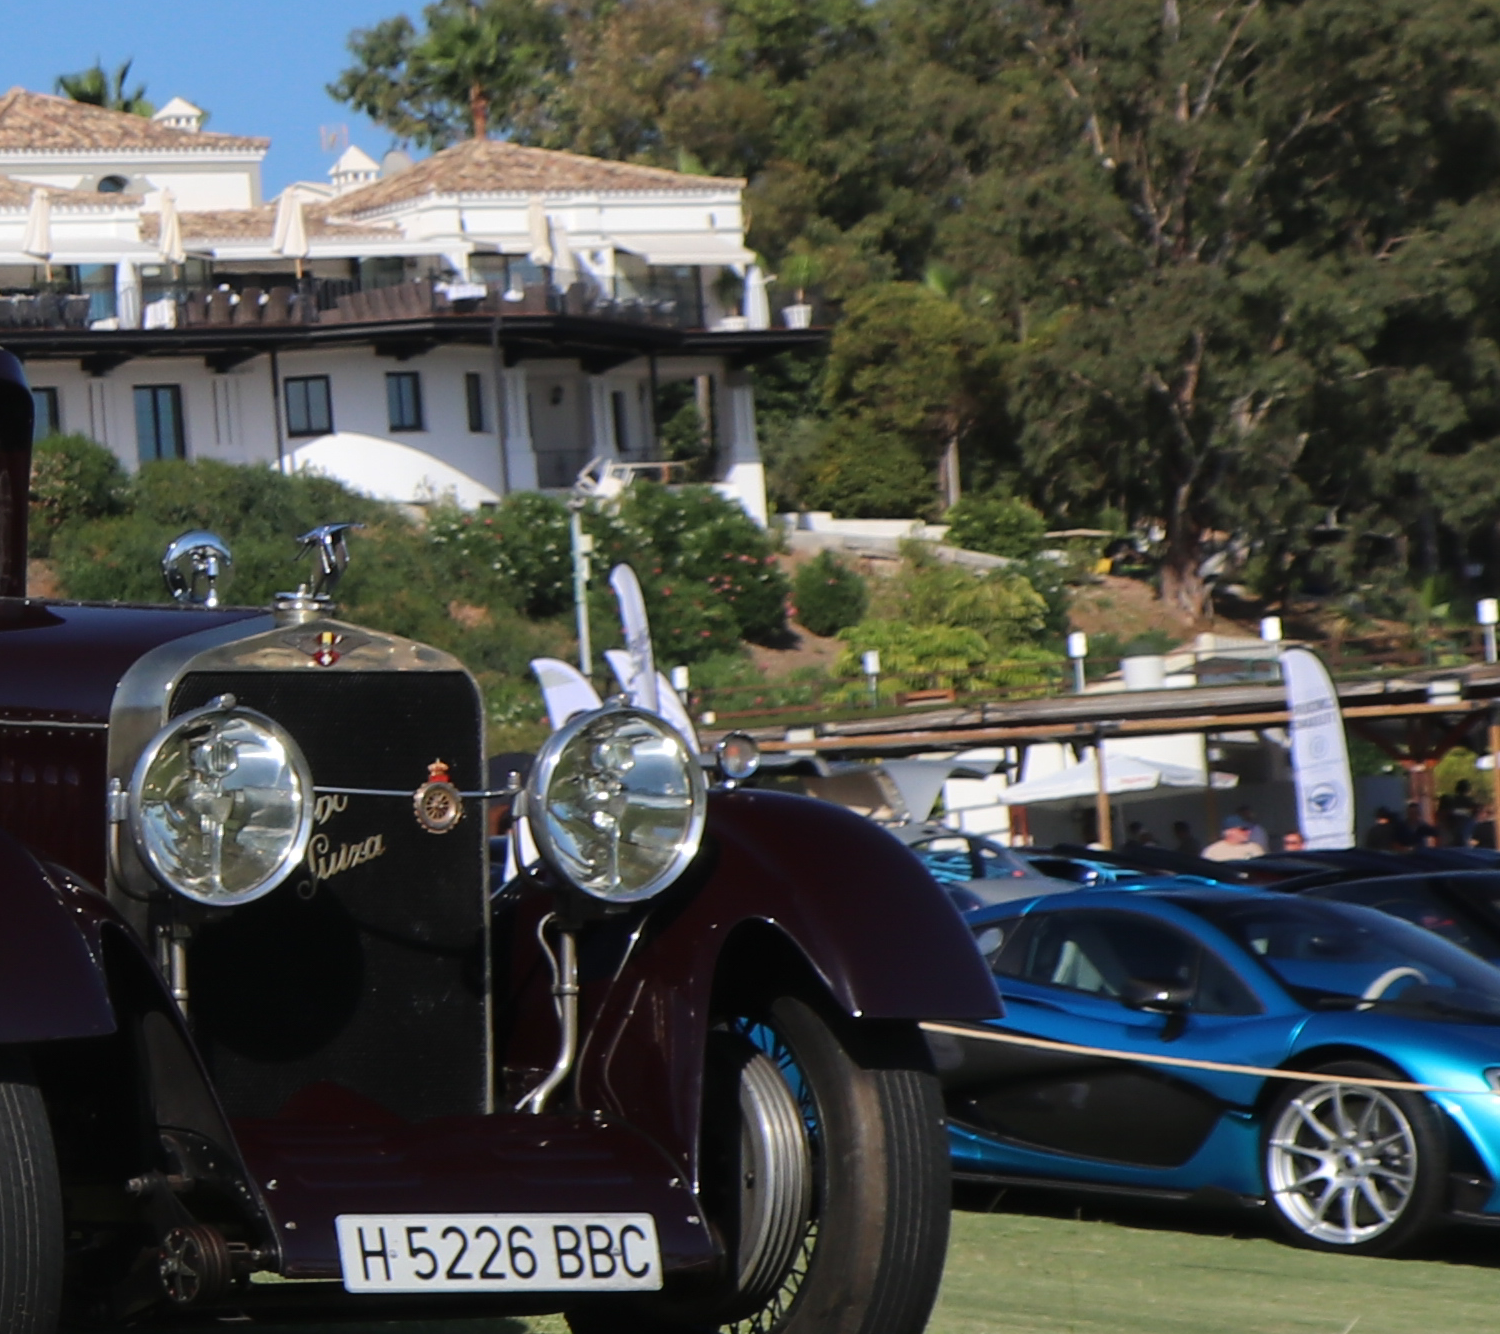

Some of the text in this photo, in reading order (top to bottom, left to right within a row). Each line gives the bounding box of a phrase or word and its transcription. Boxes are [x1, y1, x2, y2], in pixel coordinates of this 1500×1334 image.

[357, 1224, 651, 1281] H 5226 BBC
